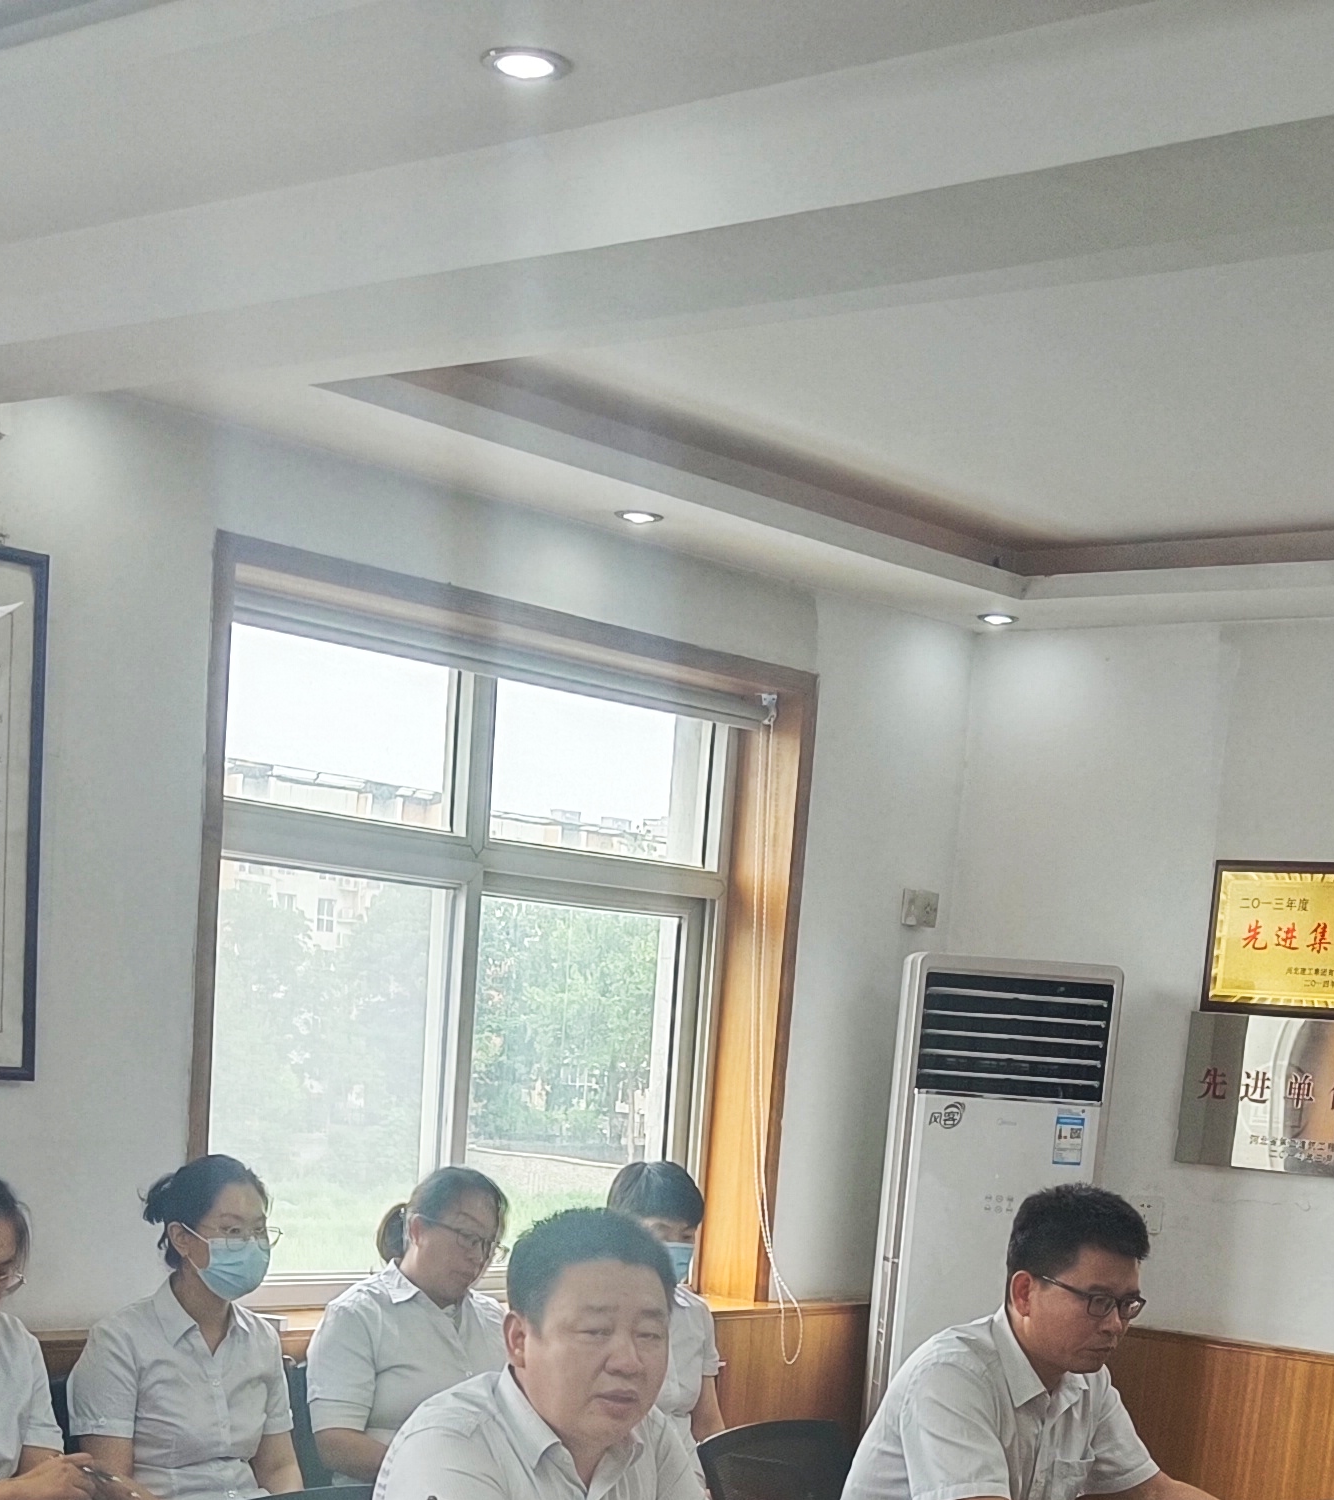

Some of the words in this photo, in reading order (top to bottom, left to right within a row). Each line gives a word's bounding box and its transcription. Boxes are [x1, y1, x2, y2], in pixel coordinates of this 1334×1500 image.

[1240, 897, 1309, 913] 二〇一三年度
